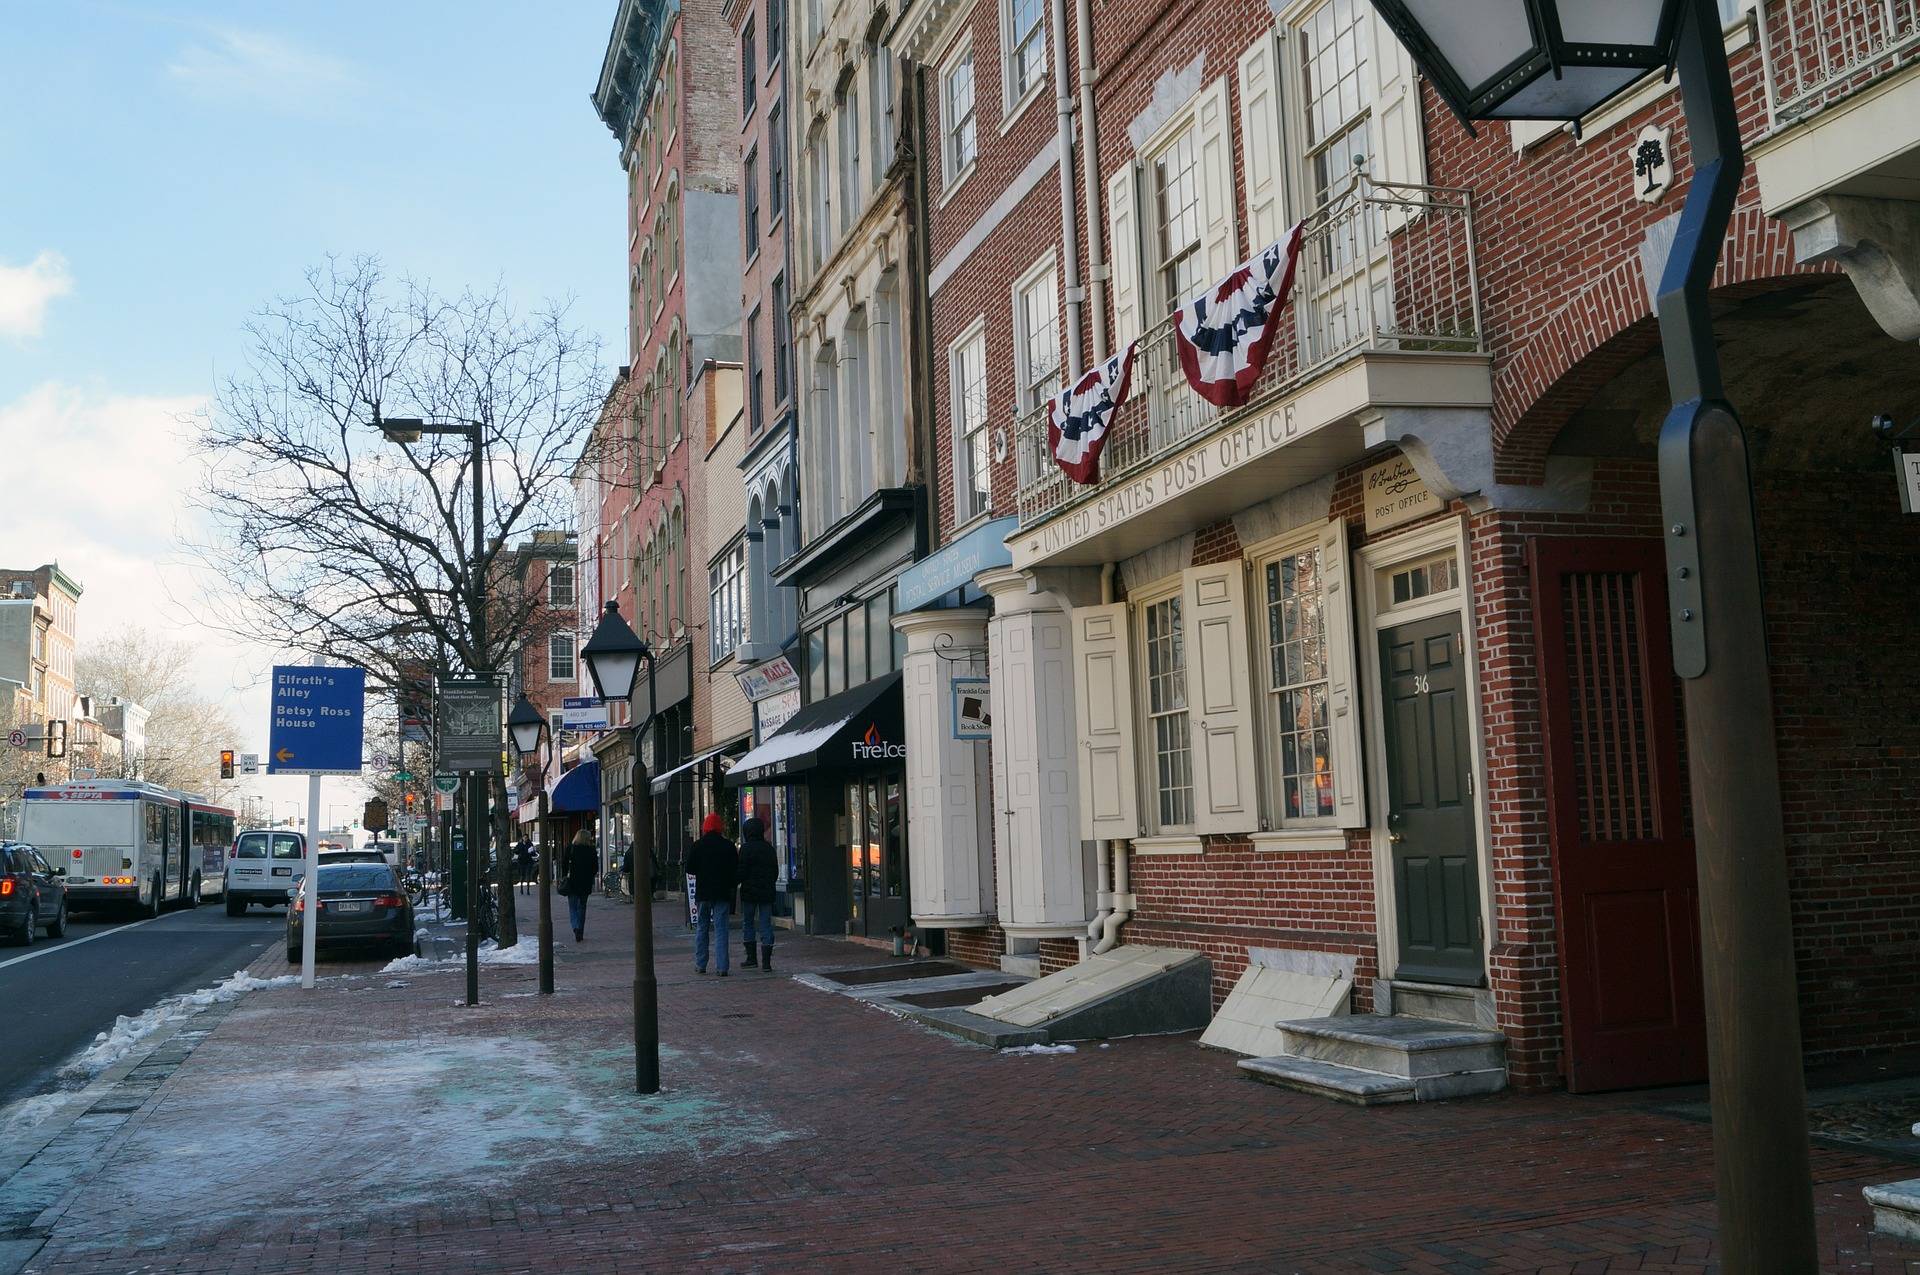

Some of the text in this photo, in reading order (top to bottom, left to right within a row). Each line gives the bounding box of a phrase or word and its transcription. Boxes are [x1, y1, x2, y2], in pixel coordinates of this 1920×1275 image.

[1043, 401, 1298, 553] UNITED STATES POST OFFICE
[1375, 490, 1429, 518] POST OFFICE
[278, 675, 335, 686] Elfreth's
[1414, 674, 1429, 695] 316
[277, 687, 311, 699] Alley
[276, 705, 352, 717] Betsy Ross
[276, 717, 317, 728] House
[760, 713, 782, 730] MASSAGE
